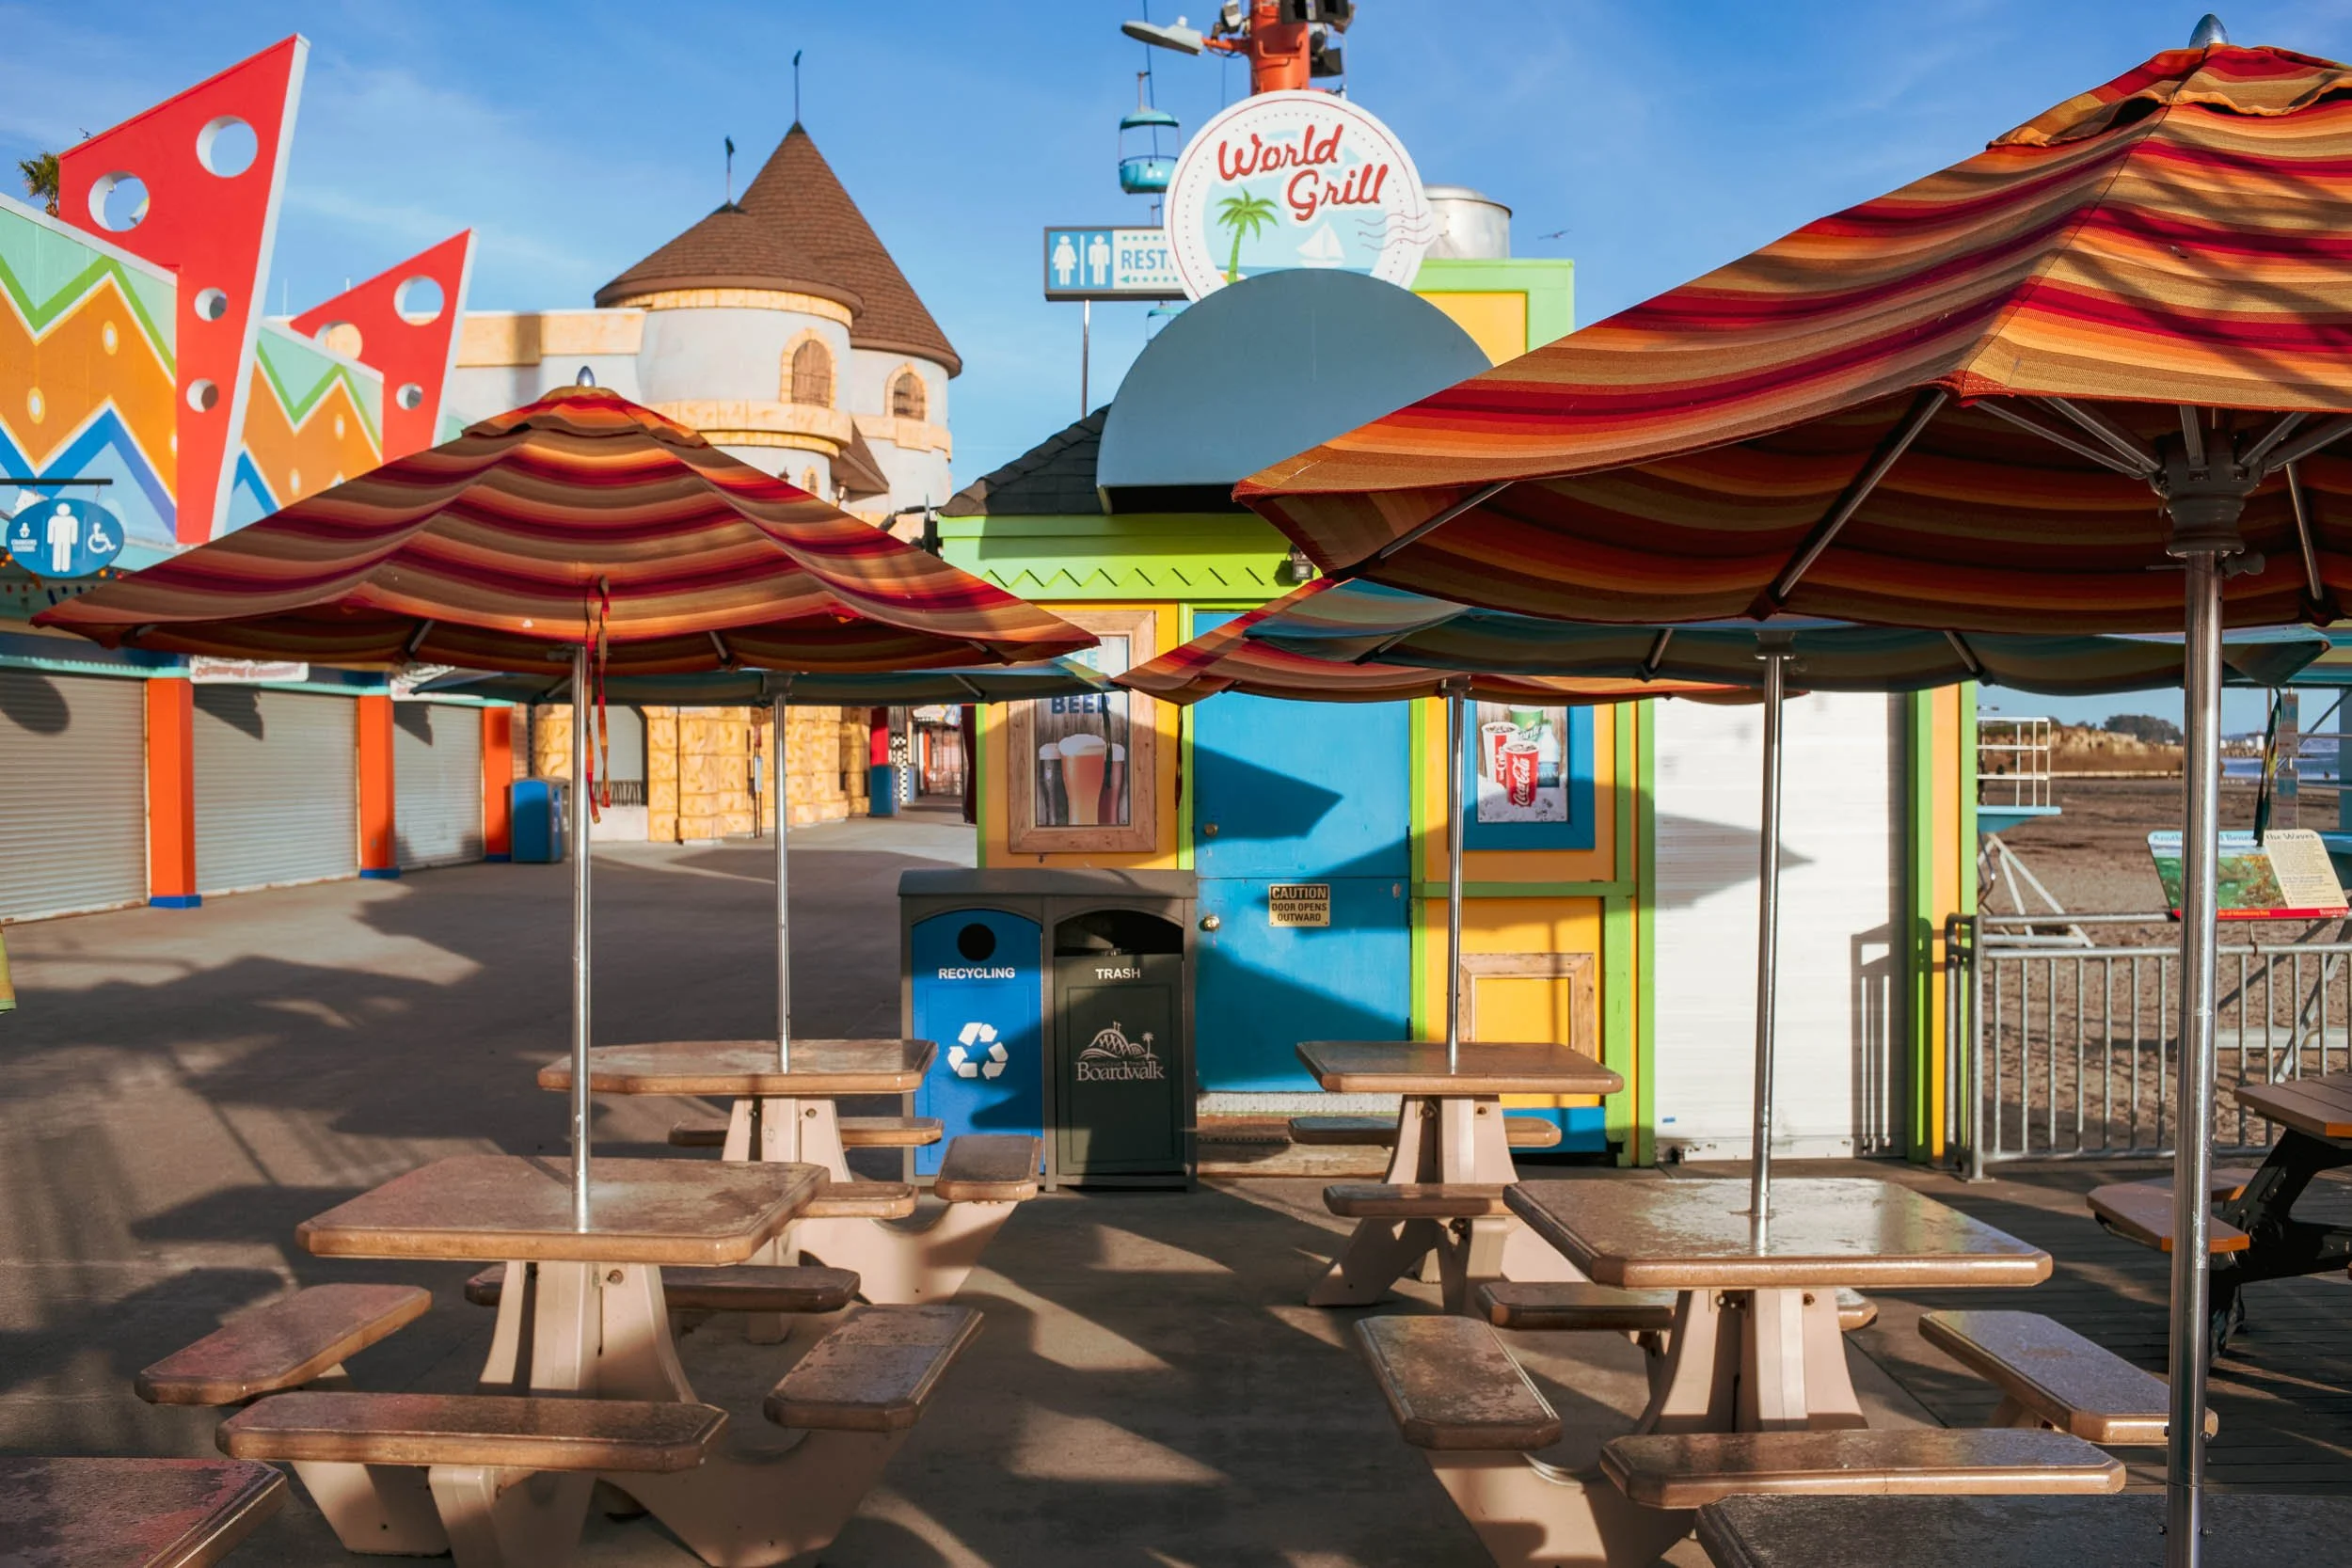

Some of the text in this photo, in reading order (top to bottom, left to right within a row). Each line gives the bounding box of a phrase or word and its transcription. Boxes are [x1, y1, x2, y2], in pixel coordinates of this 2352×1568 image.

[1217, 123, 1344, 181] World
[1287, 163, 1389, 221] Grill
[1120, 248, 1173, 271] REST
[1272, 887, 1327, 899] CAUTION
[1271, 902, 1327, 911] DOOR OPENS
[1278, 912, 1321, 922] OUTWARD
[938, 967, 1016, 980] RECYCLING
[1094, 968, 1141, 980] TRASH
[1074, 1060, 1166, 1081] Boardwalk
